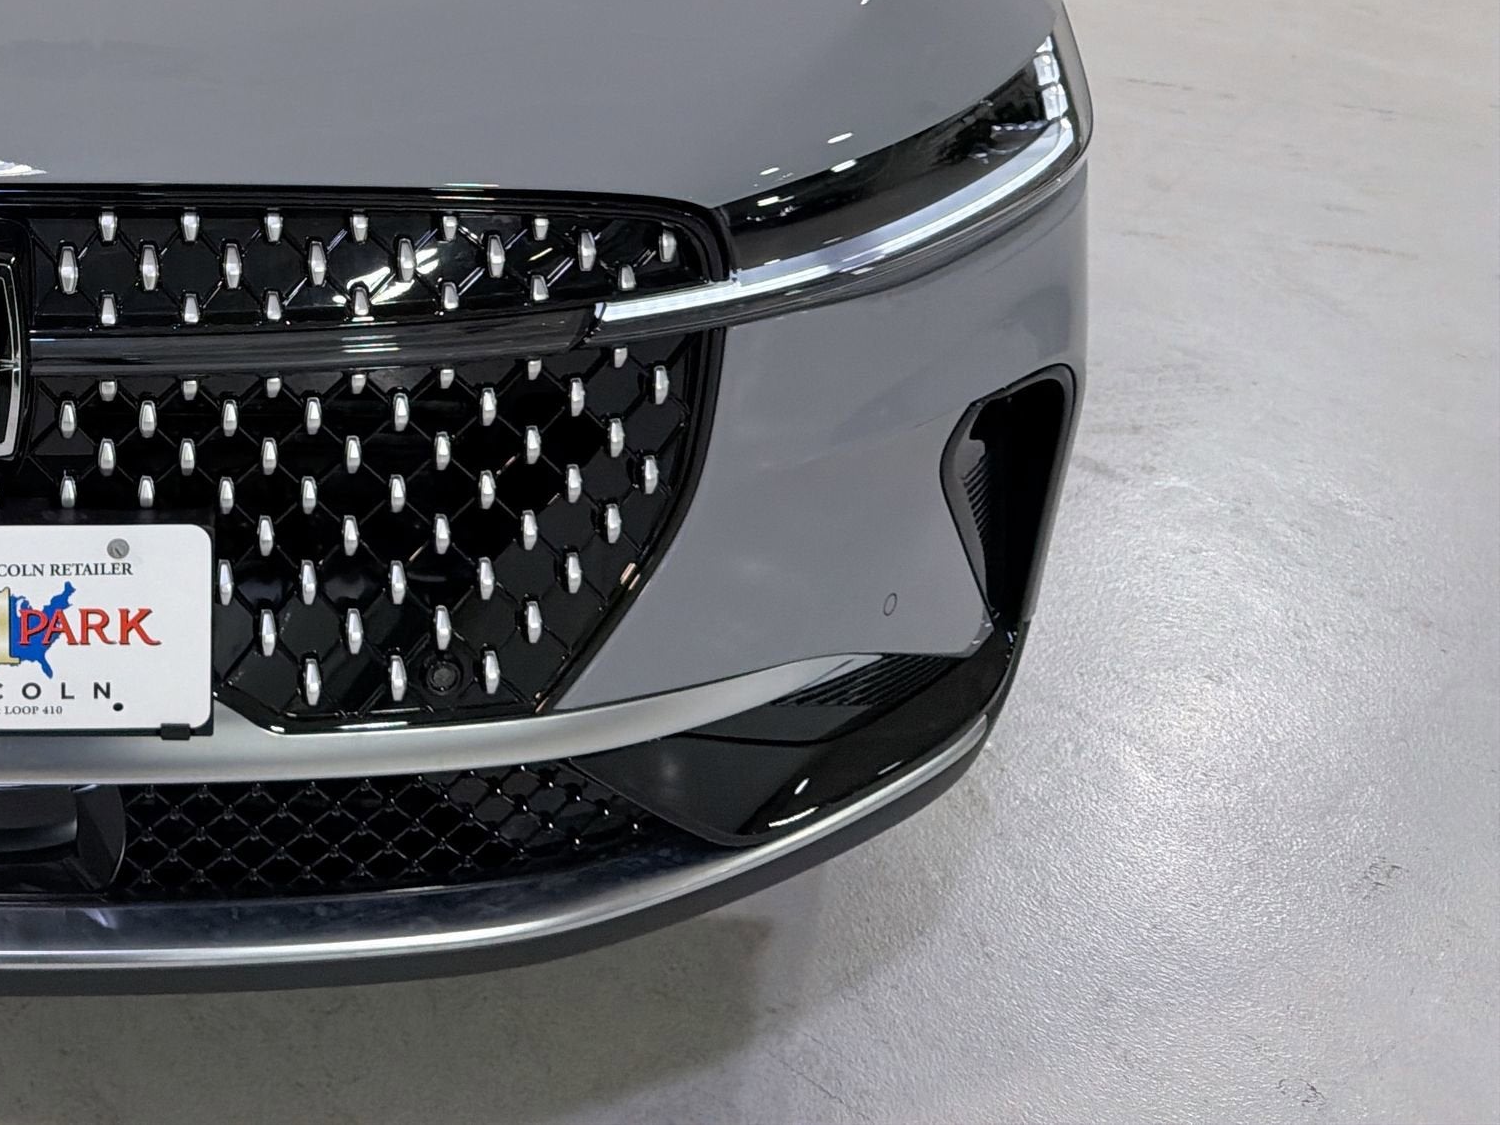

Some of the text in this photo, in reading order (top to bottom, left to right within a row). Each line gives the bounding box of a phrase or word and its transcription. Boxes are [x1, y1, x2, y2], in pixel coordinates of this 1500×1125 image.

[50, 562, 134, 577] RETAILER
[18, 608, 162, 646] PARK
[4, 705, 40, 716] LOOP
[41, 705, 63, 716] 410
